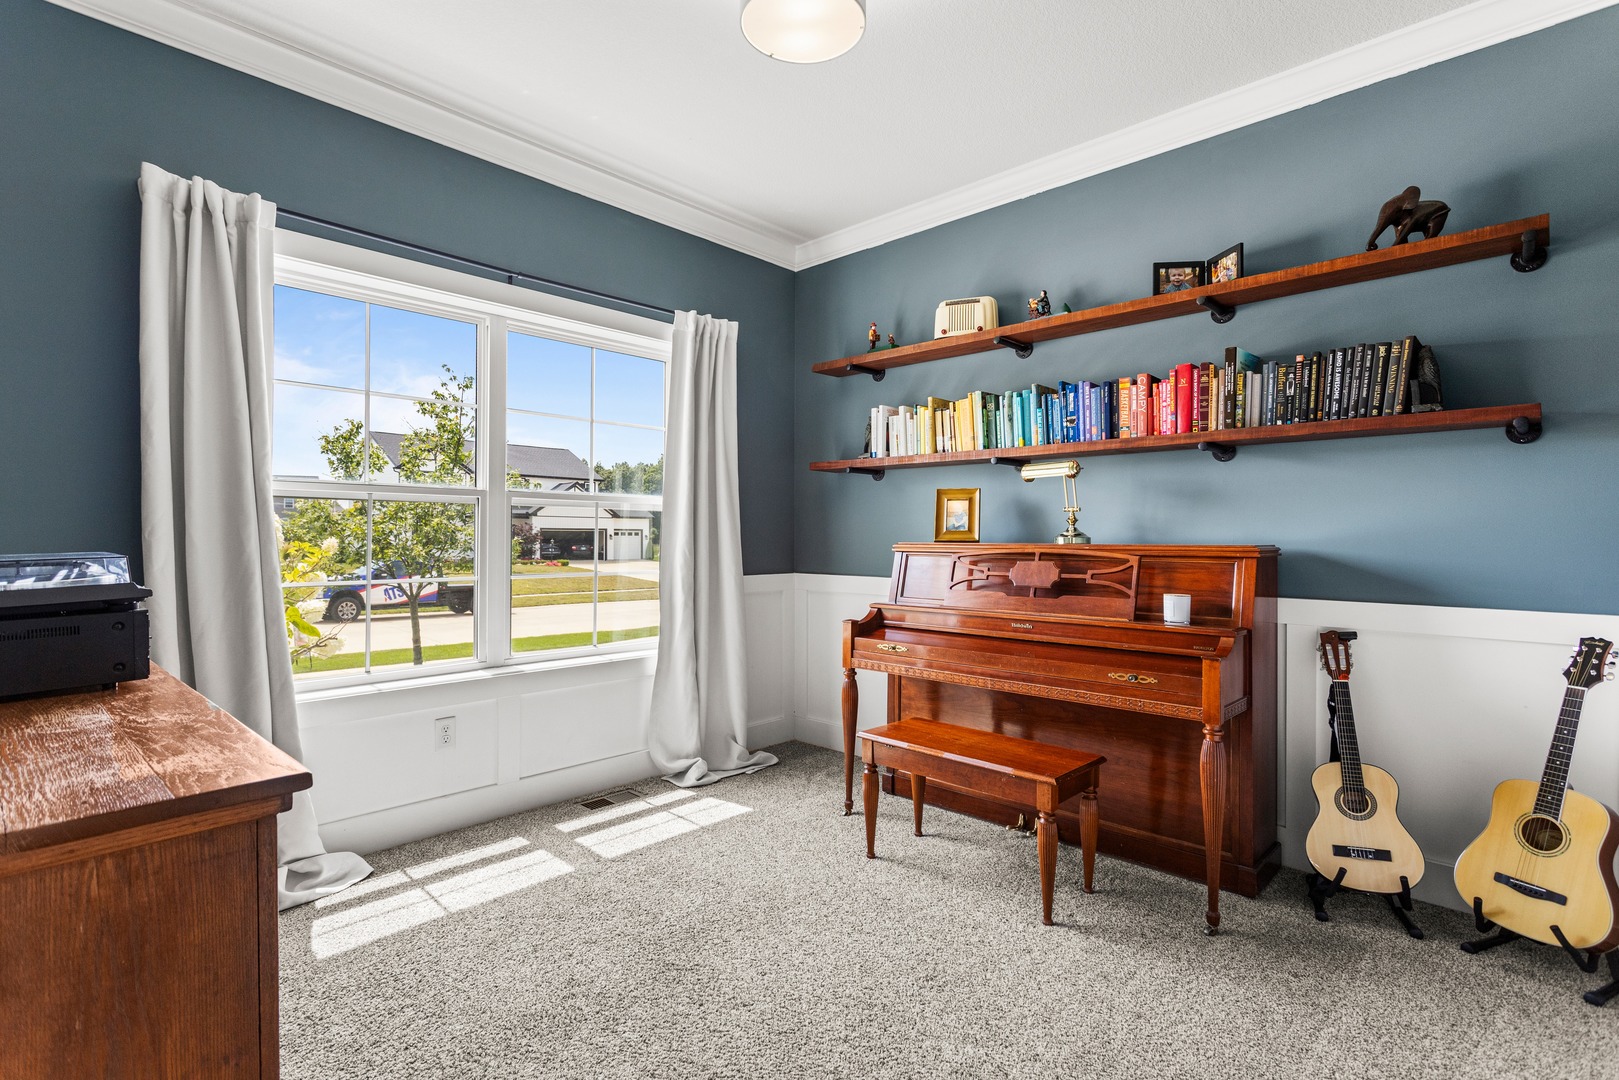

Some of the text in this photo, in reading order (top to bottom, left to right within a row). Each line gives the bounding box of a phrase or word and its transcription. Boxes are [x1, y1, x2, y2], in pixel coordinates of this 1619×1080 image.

[1379, 346, 1387, 357] jack
[1278, 367, 1286, 390] Buffett
[1388, 365, 1397, 393] WINNING
[384, 587, 404, 602] ATS
